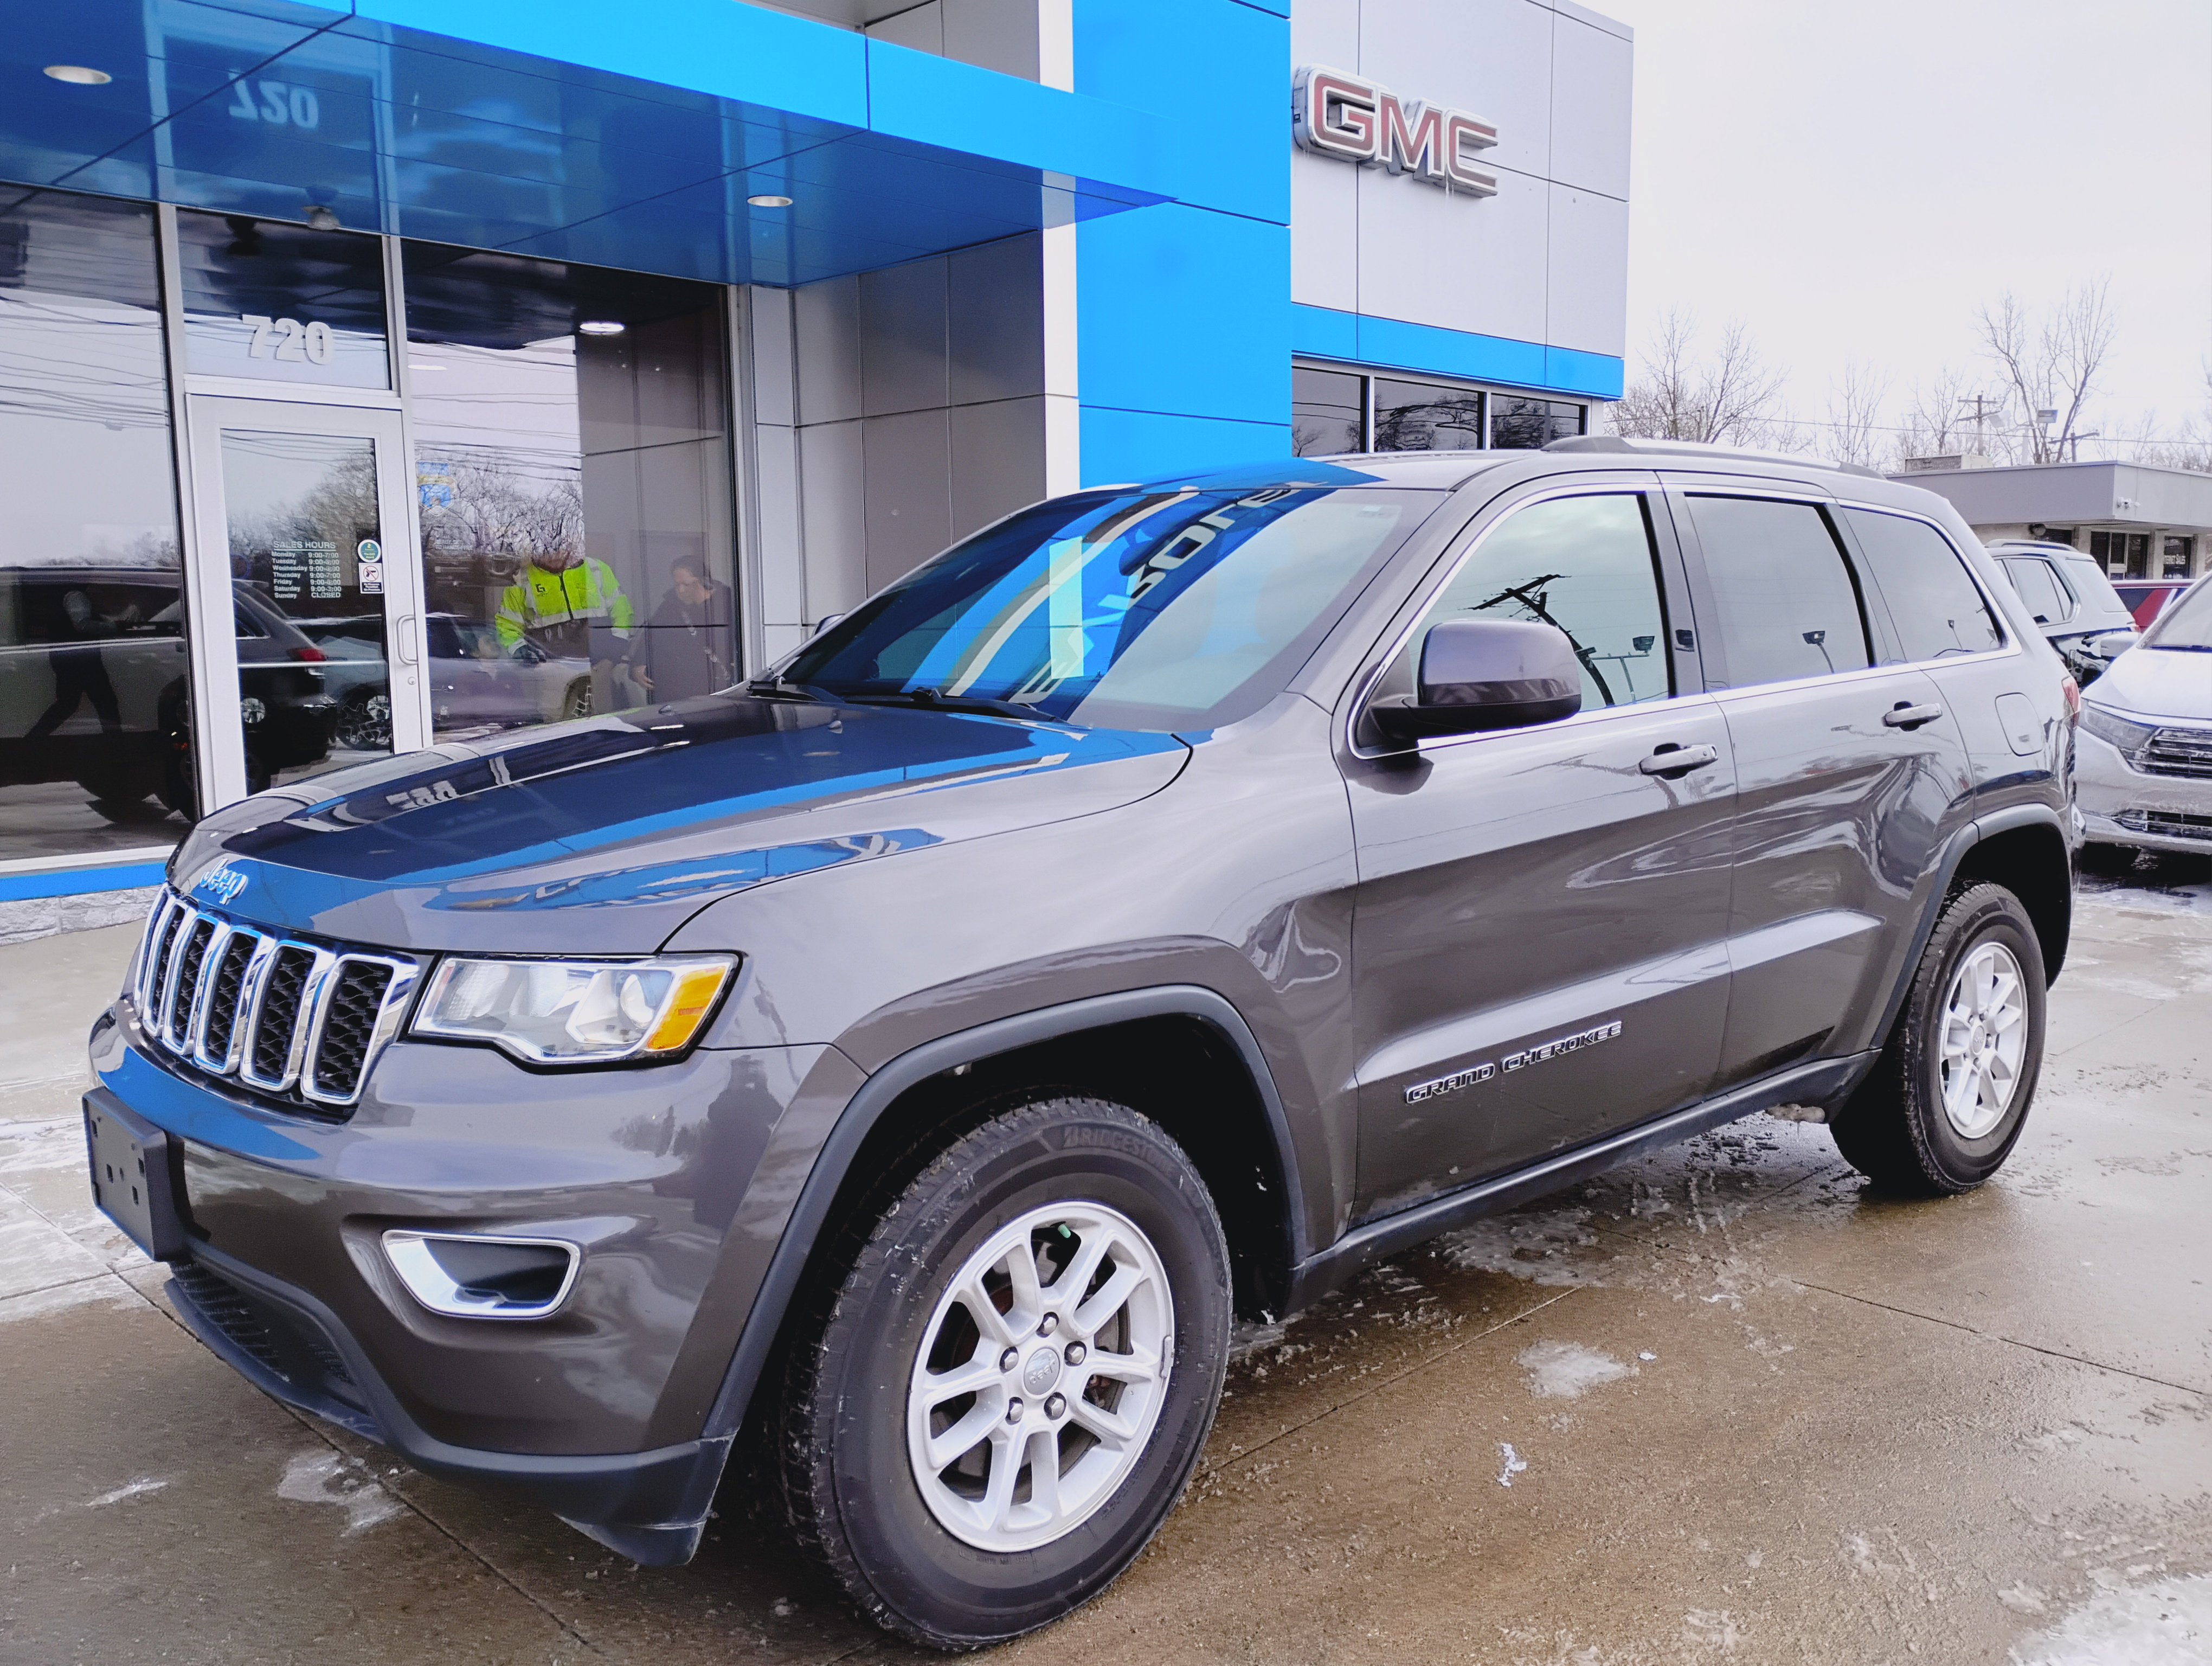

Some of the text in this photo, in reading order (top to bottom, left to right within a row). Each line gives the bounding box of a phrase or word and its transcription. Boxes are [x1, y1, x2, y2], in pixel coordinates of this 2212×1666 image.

[1293, 64, 1499, 197] GMC
[242, 314, 333, 366] 720
[200, 858, 249, 905] Jeep
[1405, 1021, 1622, 1104] GRAND CHEROKEE
